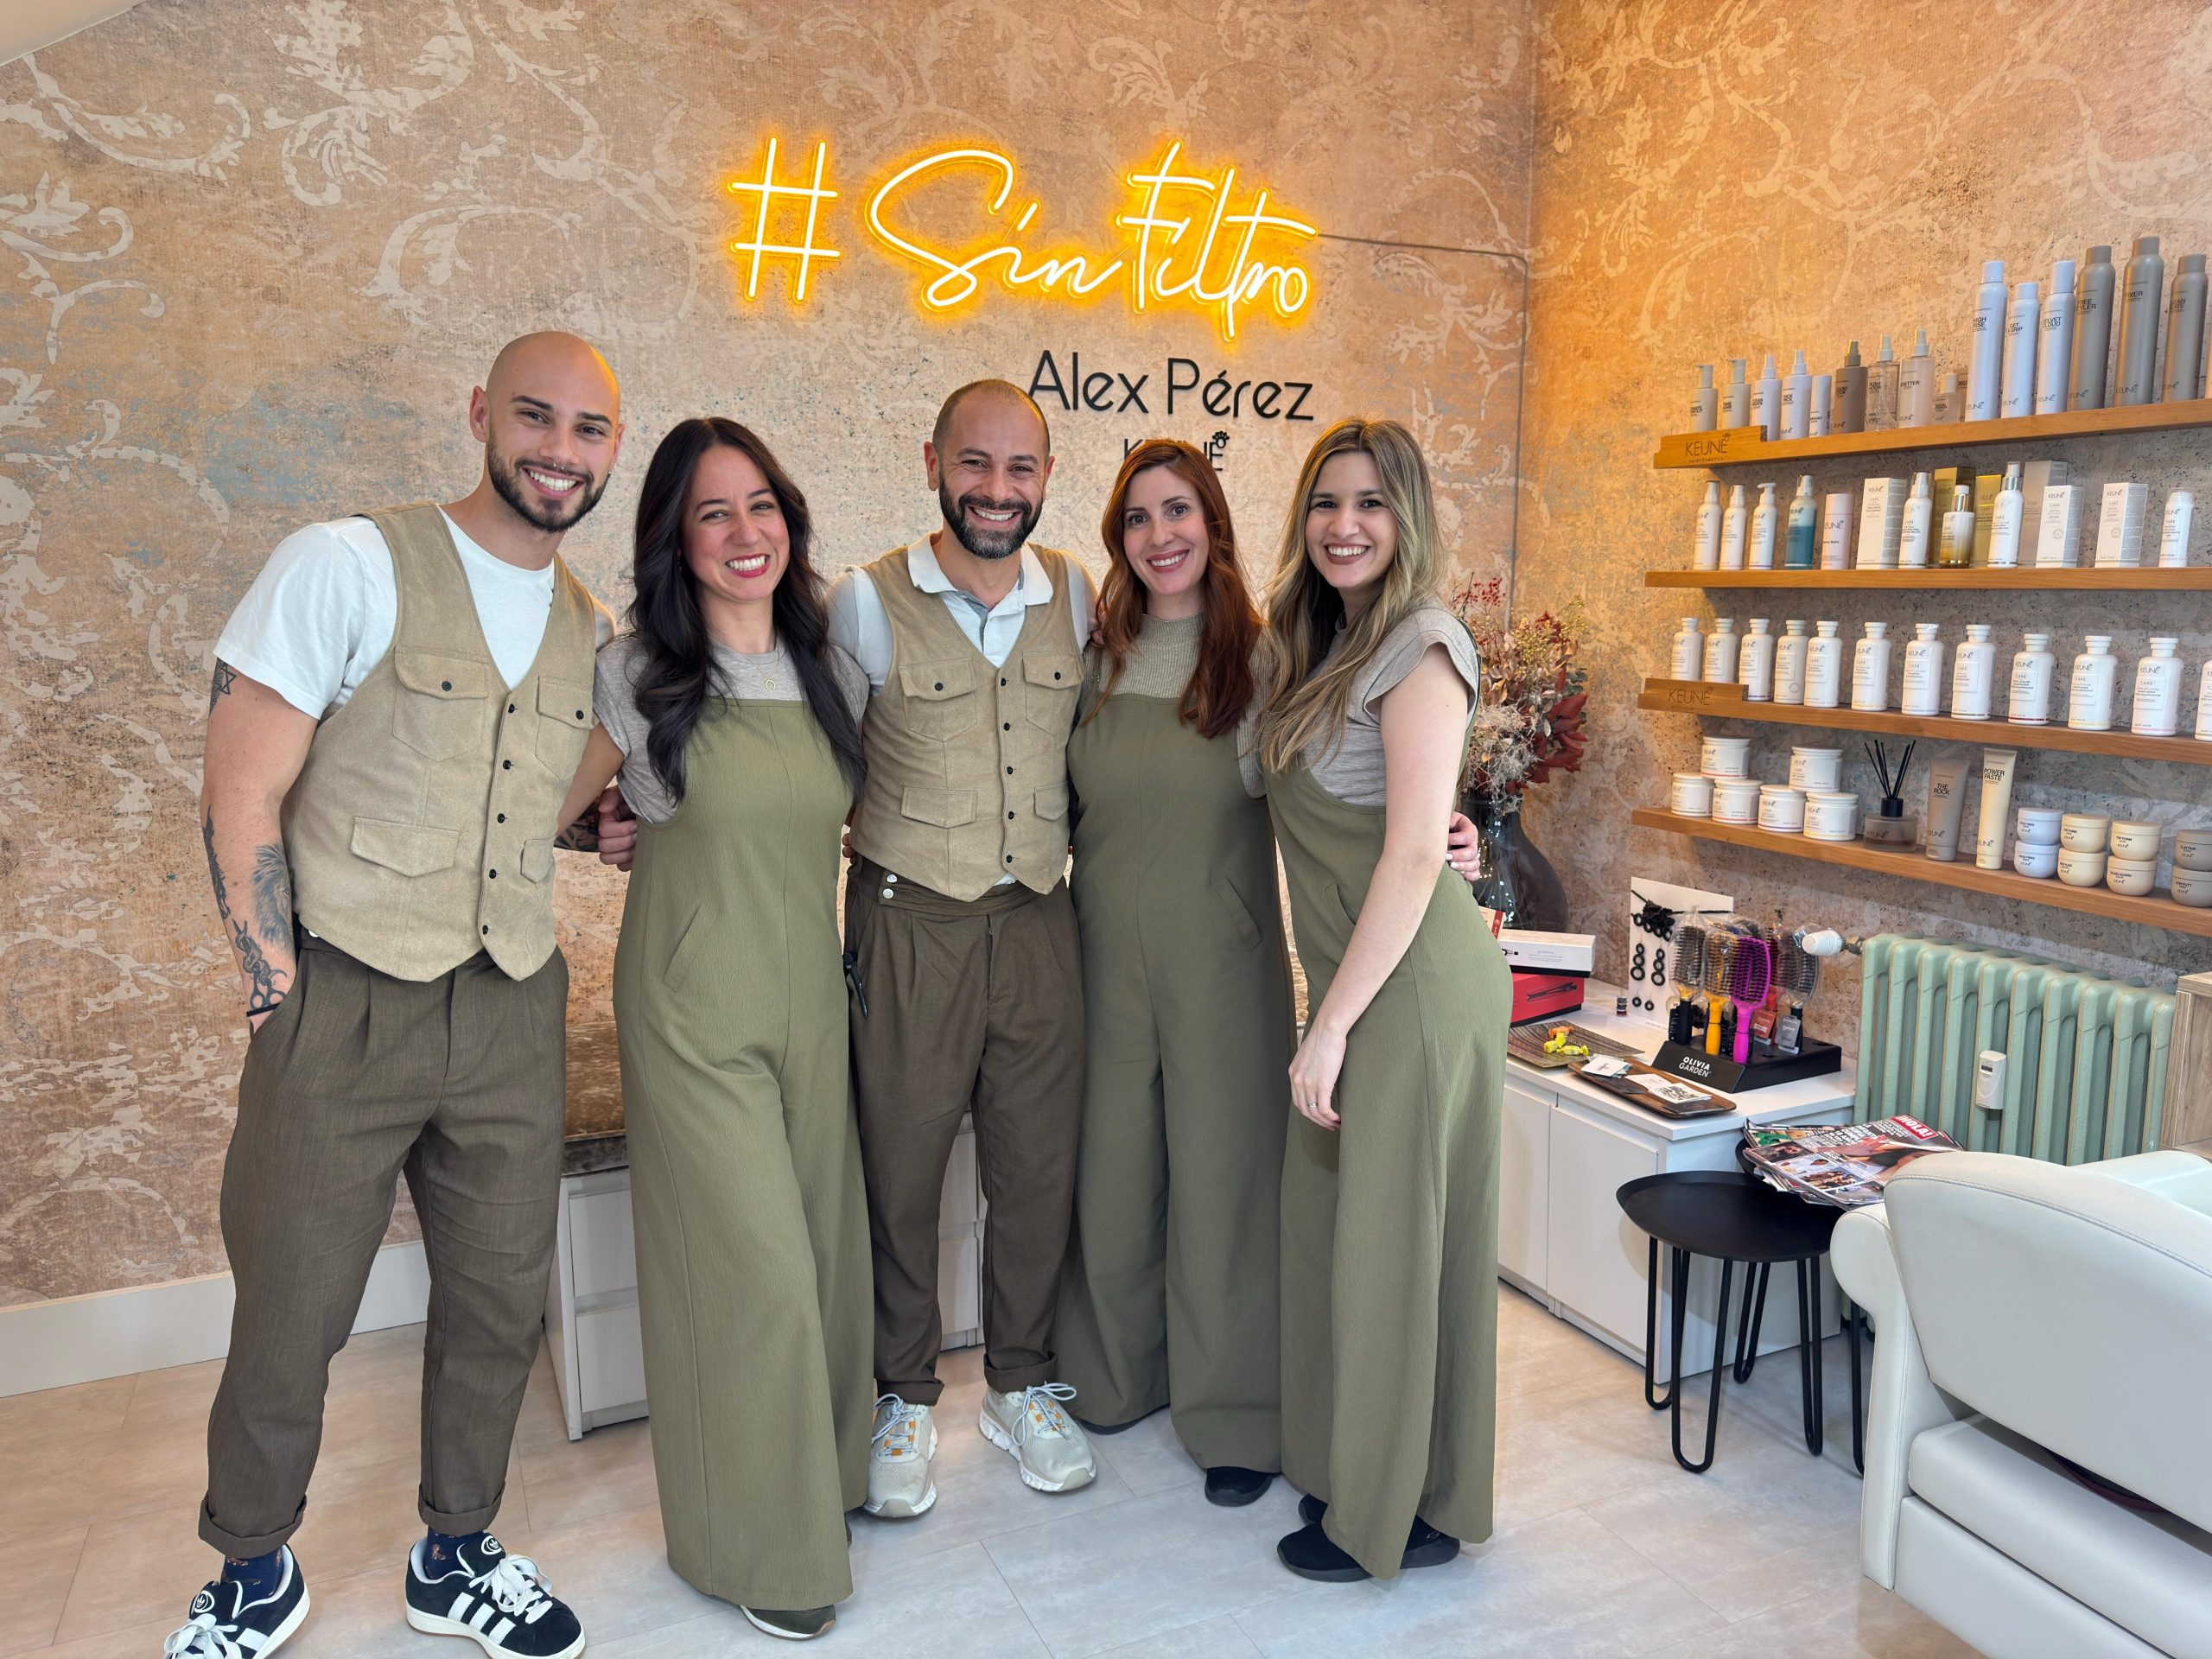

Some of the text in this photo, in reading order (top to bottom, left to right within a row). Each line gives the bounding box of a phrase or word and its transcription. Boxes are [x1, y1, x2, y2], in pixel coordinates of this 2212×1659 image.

[1029, 350, 1314, 421] Alex Pérez
[1685, 437, 1728, 456] KEUNE
[1824, 520, 1843, 530] EUNE
[1669, 689, 1710, 706] KEUNE
[1984, 768, 2005, 777] POWER
[1933, 787, 1950, 796] ROCK
[1679, 1062, 1709, 1077] GARDEN
[1683, 1056, 1710, 1071] OLIVIA
